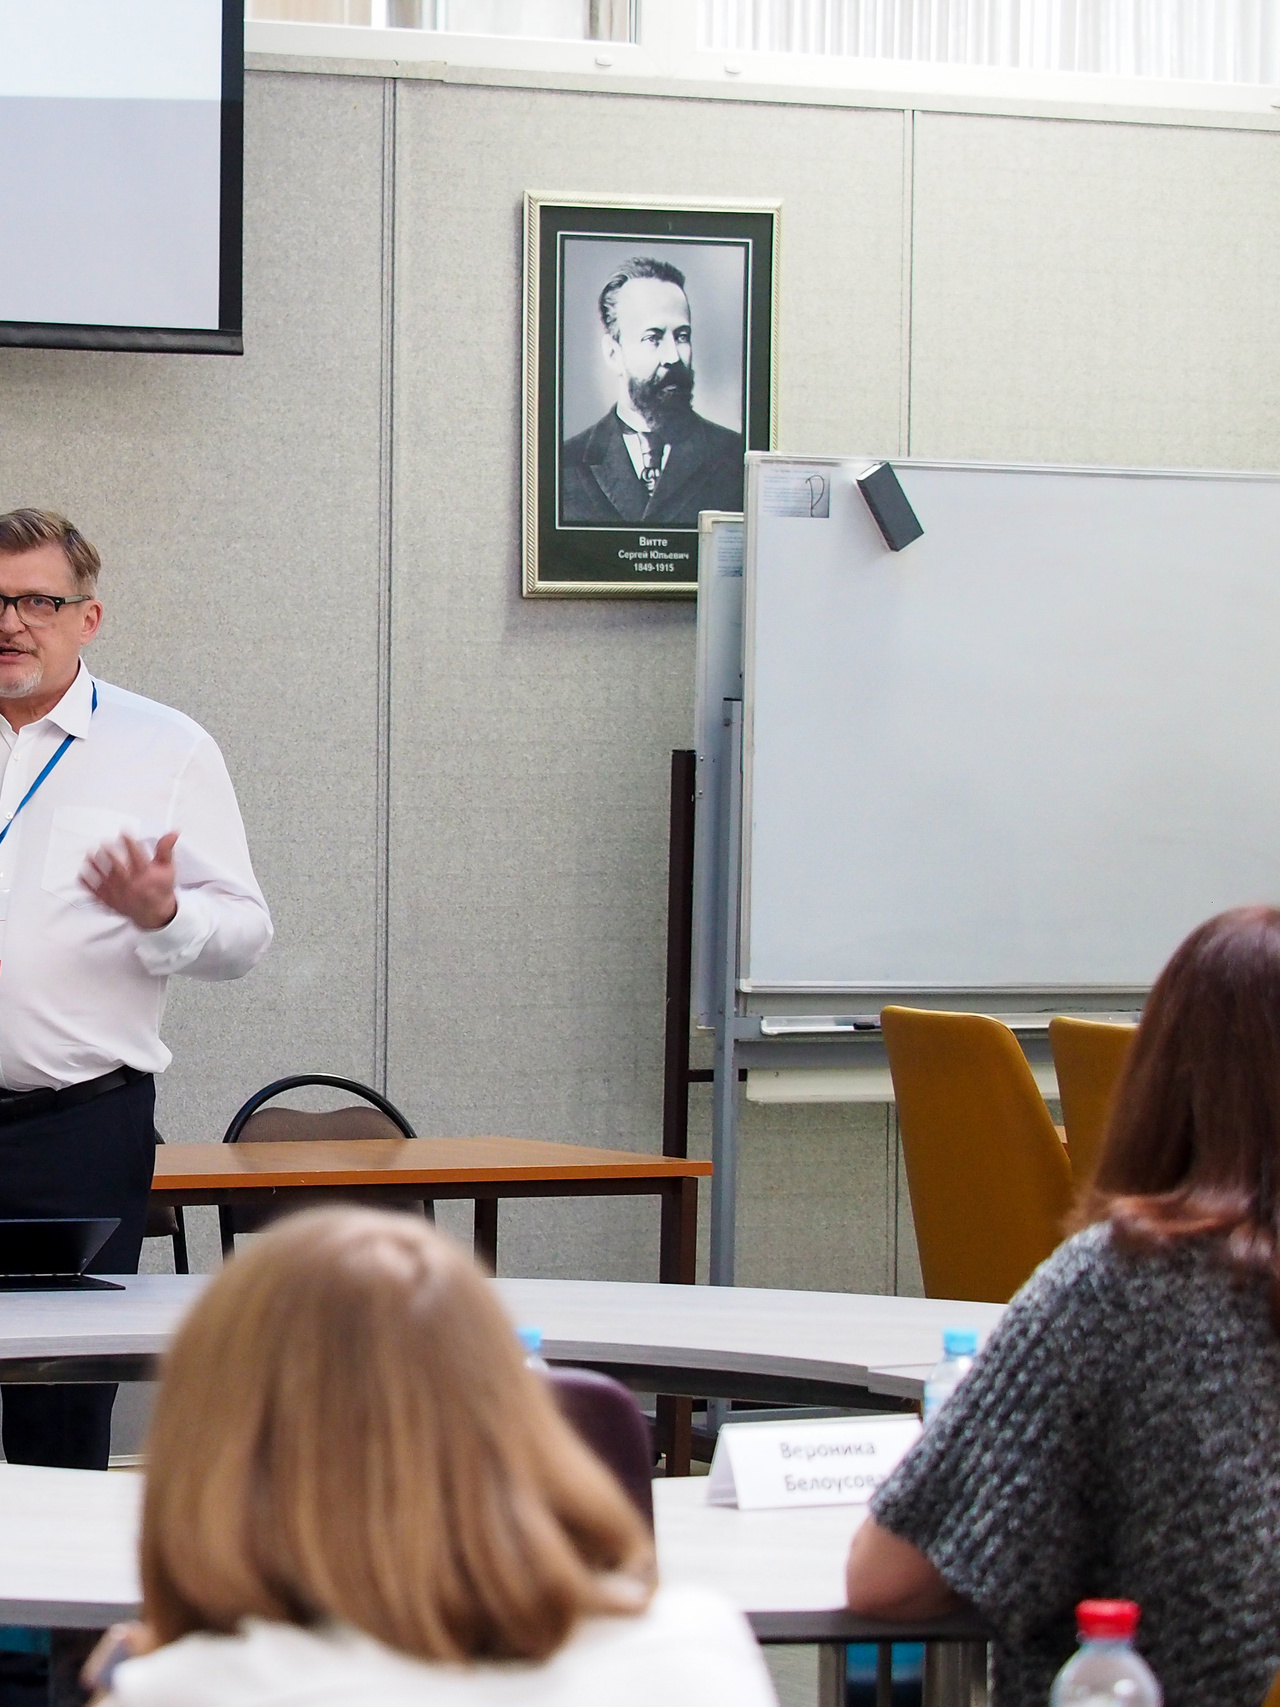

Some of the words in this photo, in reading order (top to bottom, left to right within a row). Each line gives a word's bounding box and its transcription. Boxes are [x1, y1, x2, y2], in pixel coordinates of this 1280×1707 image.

[639, 536, 668, 547] Витте
[618, 550, 648, 561] Сергей
[650, 551, 689, 560] Юльевич
[634, 563, 674, 572] 1849-1915
[780, 1441, 876, 1460] Вероника
[784, 1473, 883, 1493] Белоусов
